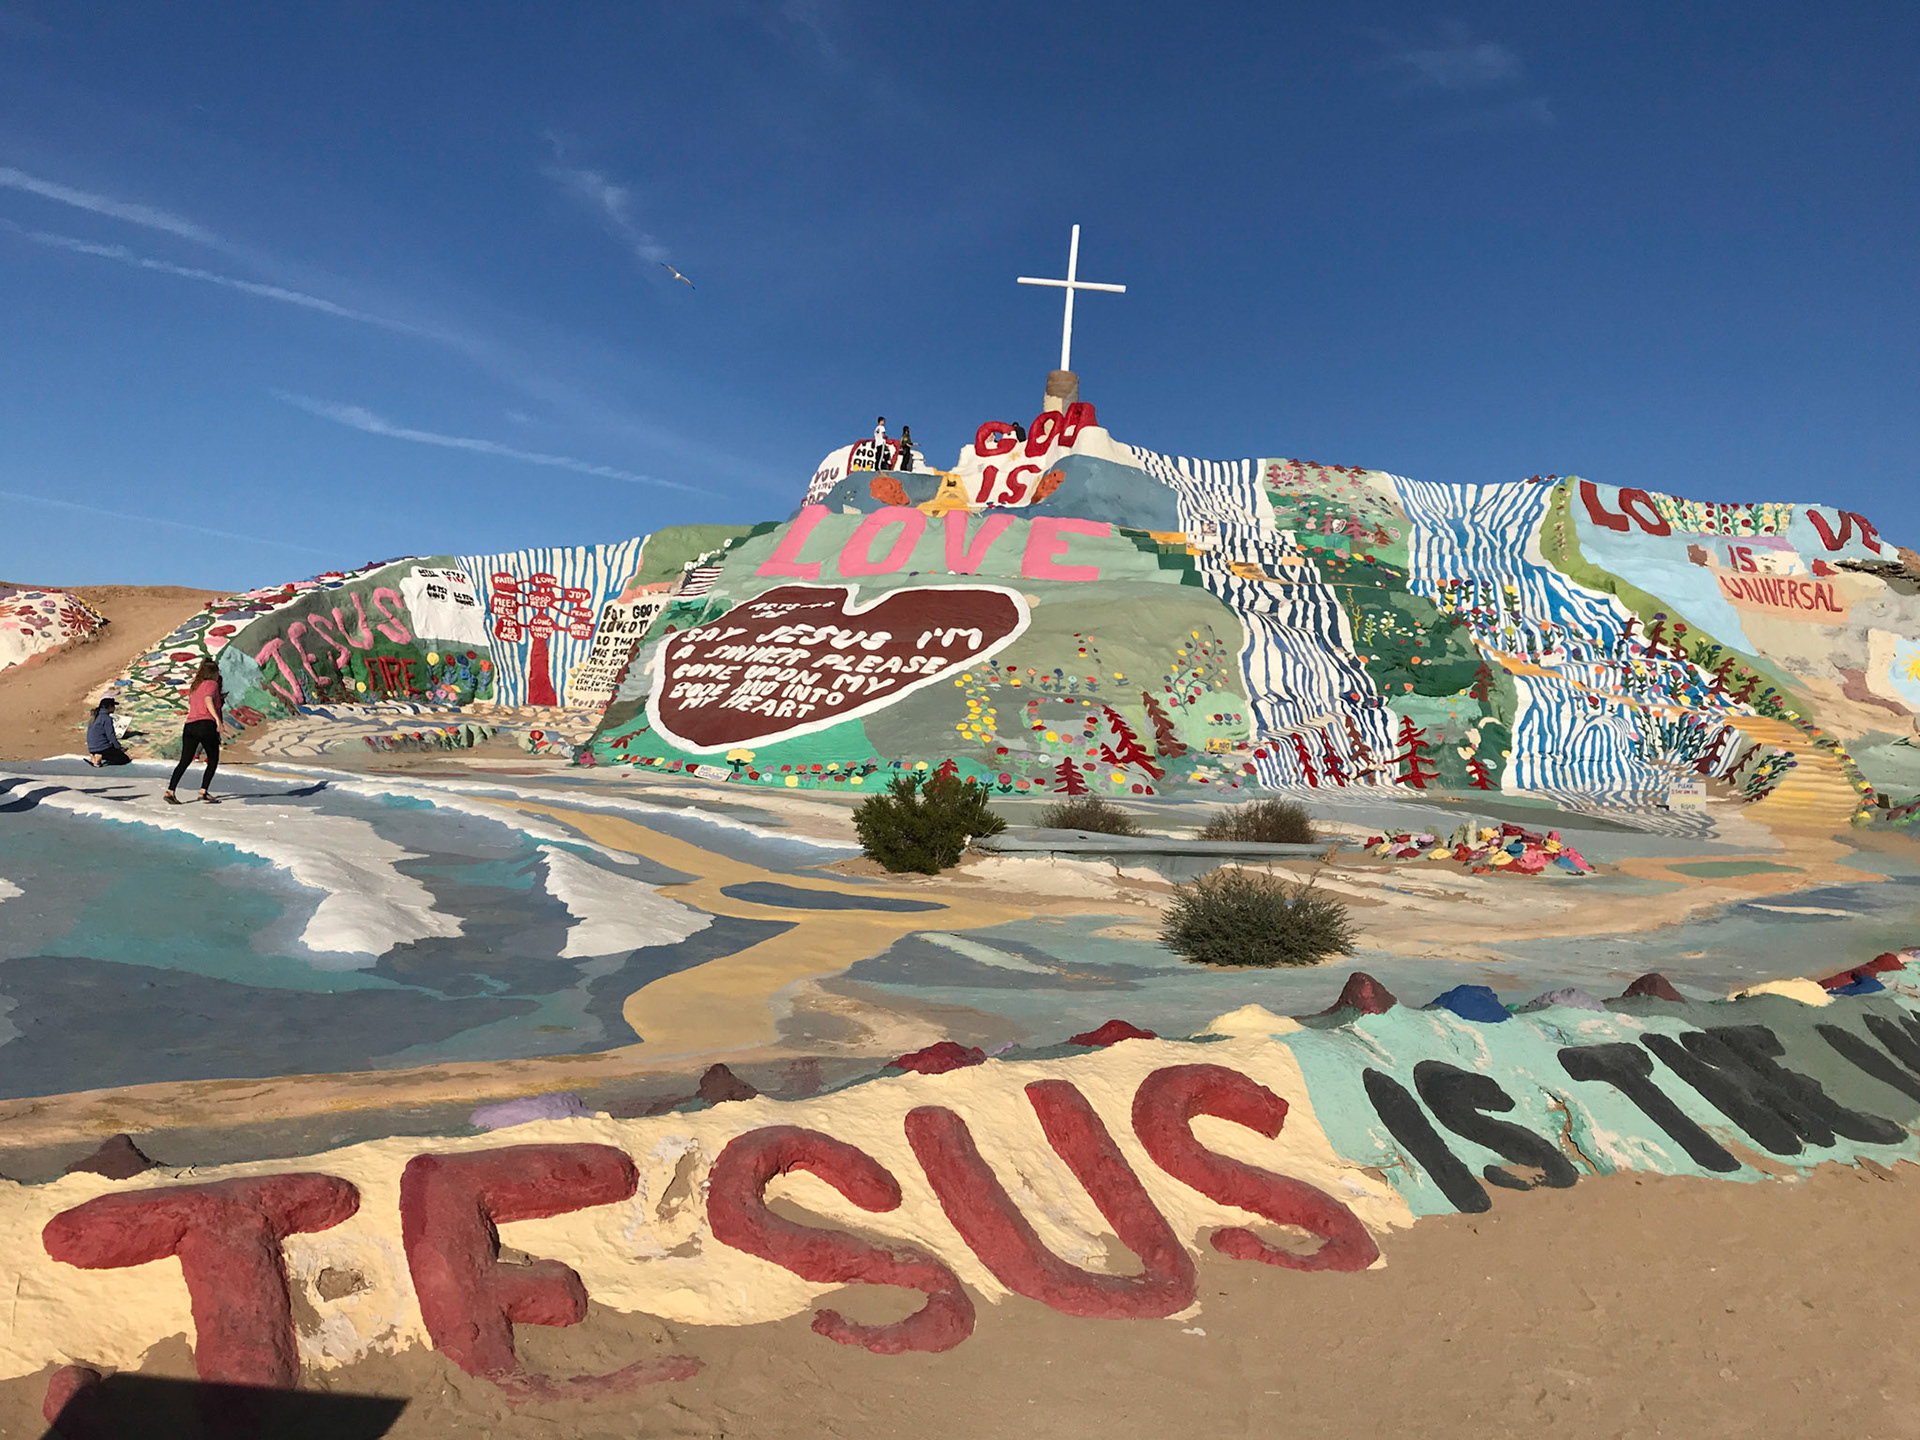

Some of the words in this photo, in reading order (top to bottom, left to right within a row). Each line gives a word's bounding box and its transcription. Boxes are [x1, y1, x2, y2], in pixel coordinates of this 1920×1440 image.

[975, 402, 1099, 458] GOD
[975, 464, 1042, 504] IS
[754, 503, 1112, 582] LOVE
[1729, 545, 1758, 573] IS
[494, 576, 515, 585] FAITH
[535, 576, 555, 585] LOVE
[568, 590, 588, 601] JOY
[1720, 576, 1843, 613] UNIVERSAL
[255, 587, 412, 704] JESUS
[681, 626, 748, 643] SAY
[755, 623, 892, 650] JESUS
[916, 627, 984, 650] I'M
[363, 655, 422, 695] FIRE
[672, 643, 697, 660] A
[703, 644, 812, 667] SINNER
[811, 653, 949, 675] PLEASE
[672, 662, 743, 680] COME
[743, 664, 823, 686] UPON
[831, 673, 896, 696] MY
[730, 679, 780, 697] AND
[781, 683, 846, 706] INTO
[678, 696, 720, 711] MY
[719, 695, 816, 719] HEART
[40, 1062, 1382, 1440] JESUS
[1362, 1059, 1580, 1215] IS
